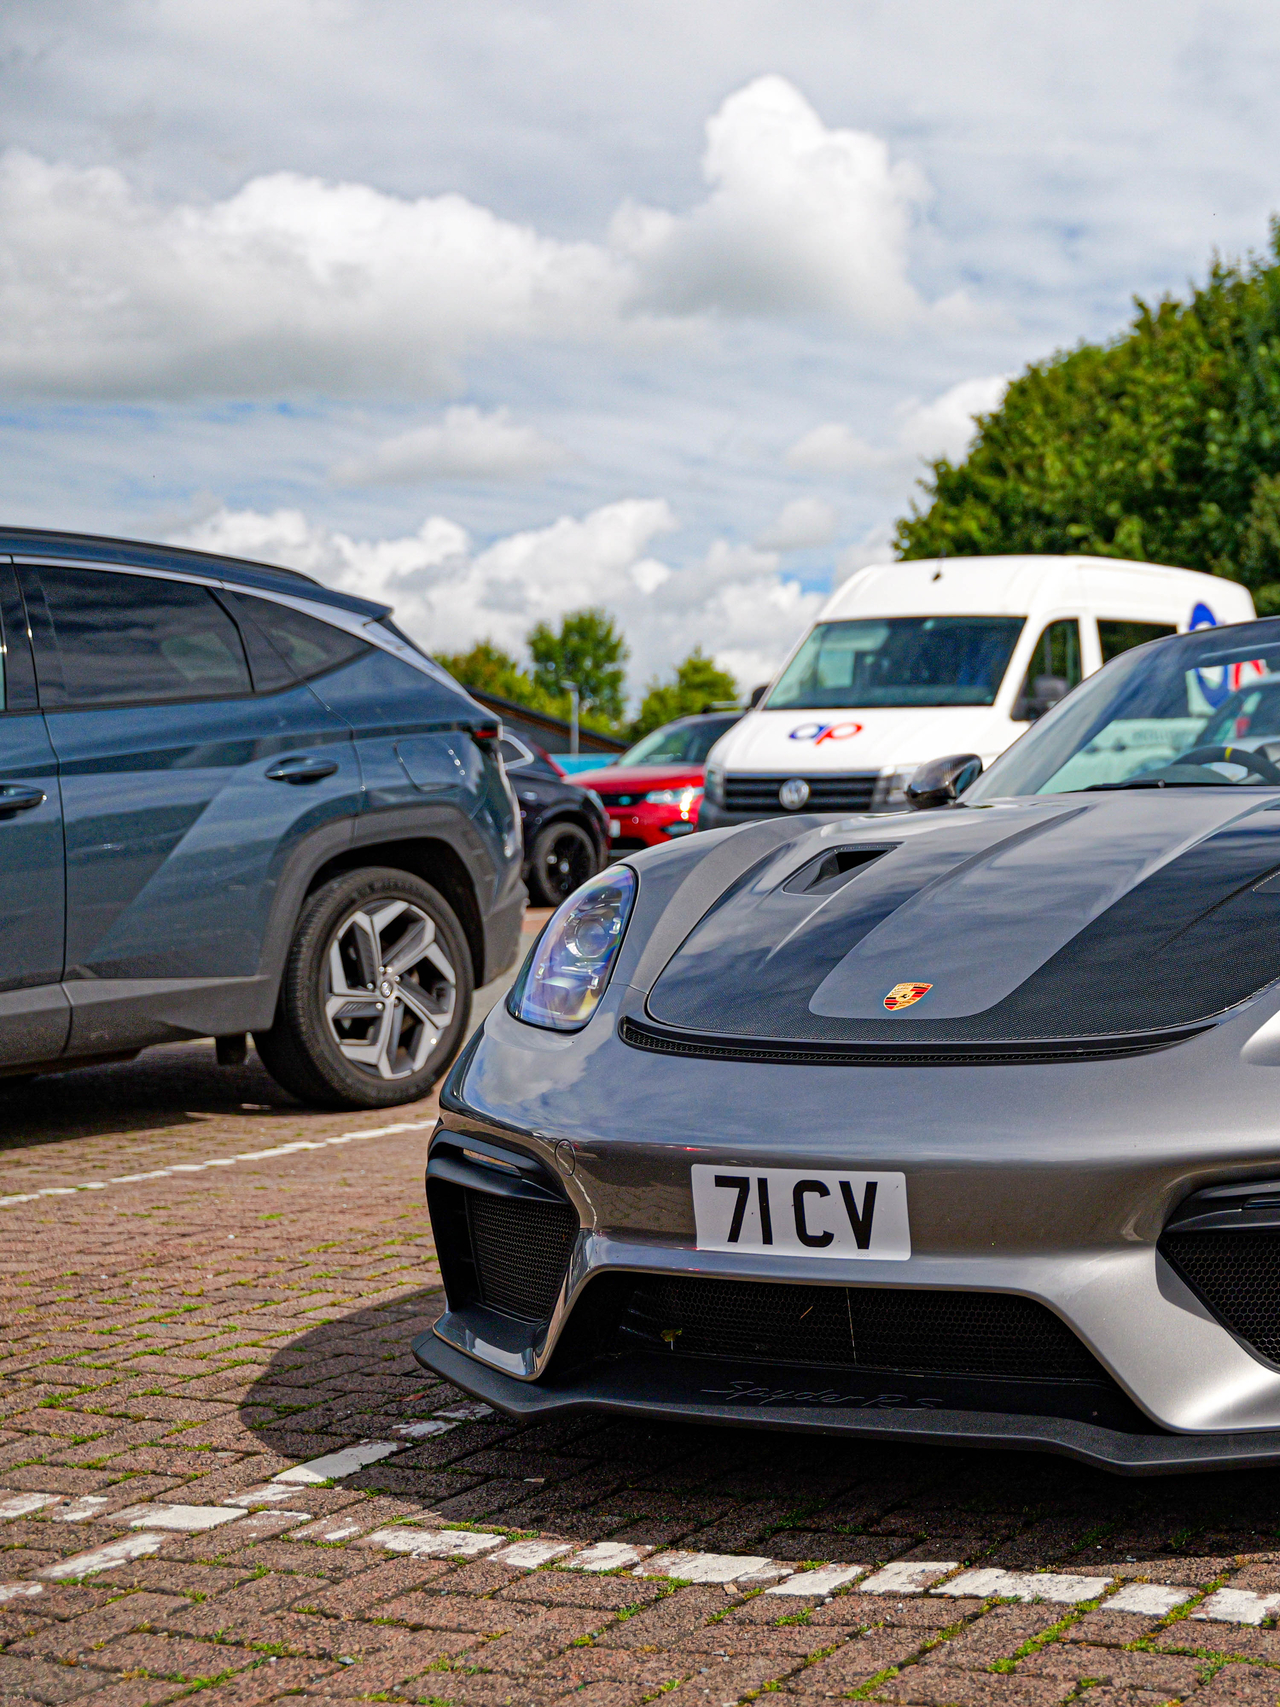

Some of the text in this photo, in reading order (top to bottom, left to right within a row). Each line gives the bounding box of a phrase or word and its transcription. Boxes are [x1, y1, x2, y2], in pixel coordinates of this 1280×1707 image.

[714, 1175, 878, 1250] 71 CV
[700, 1380, 865, 1406] Spyder
